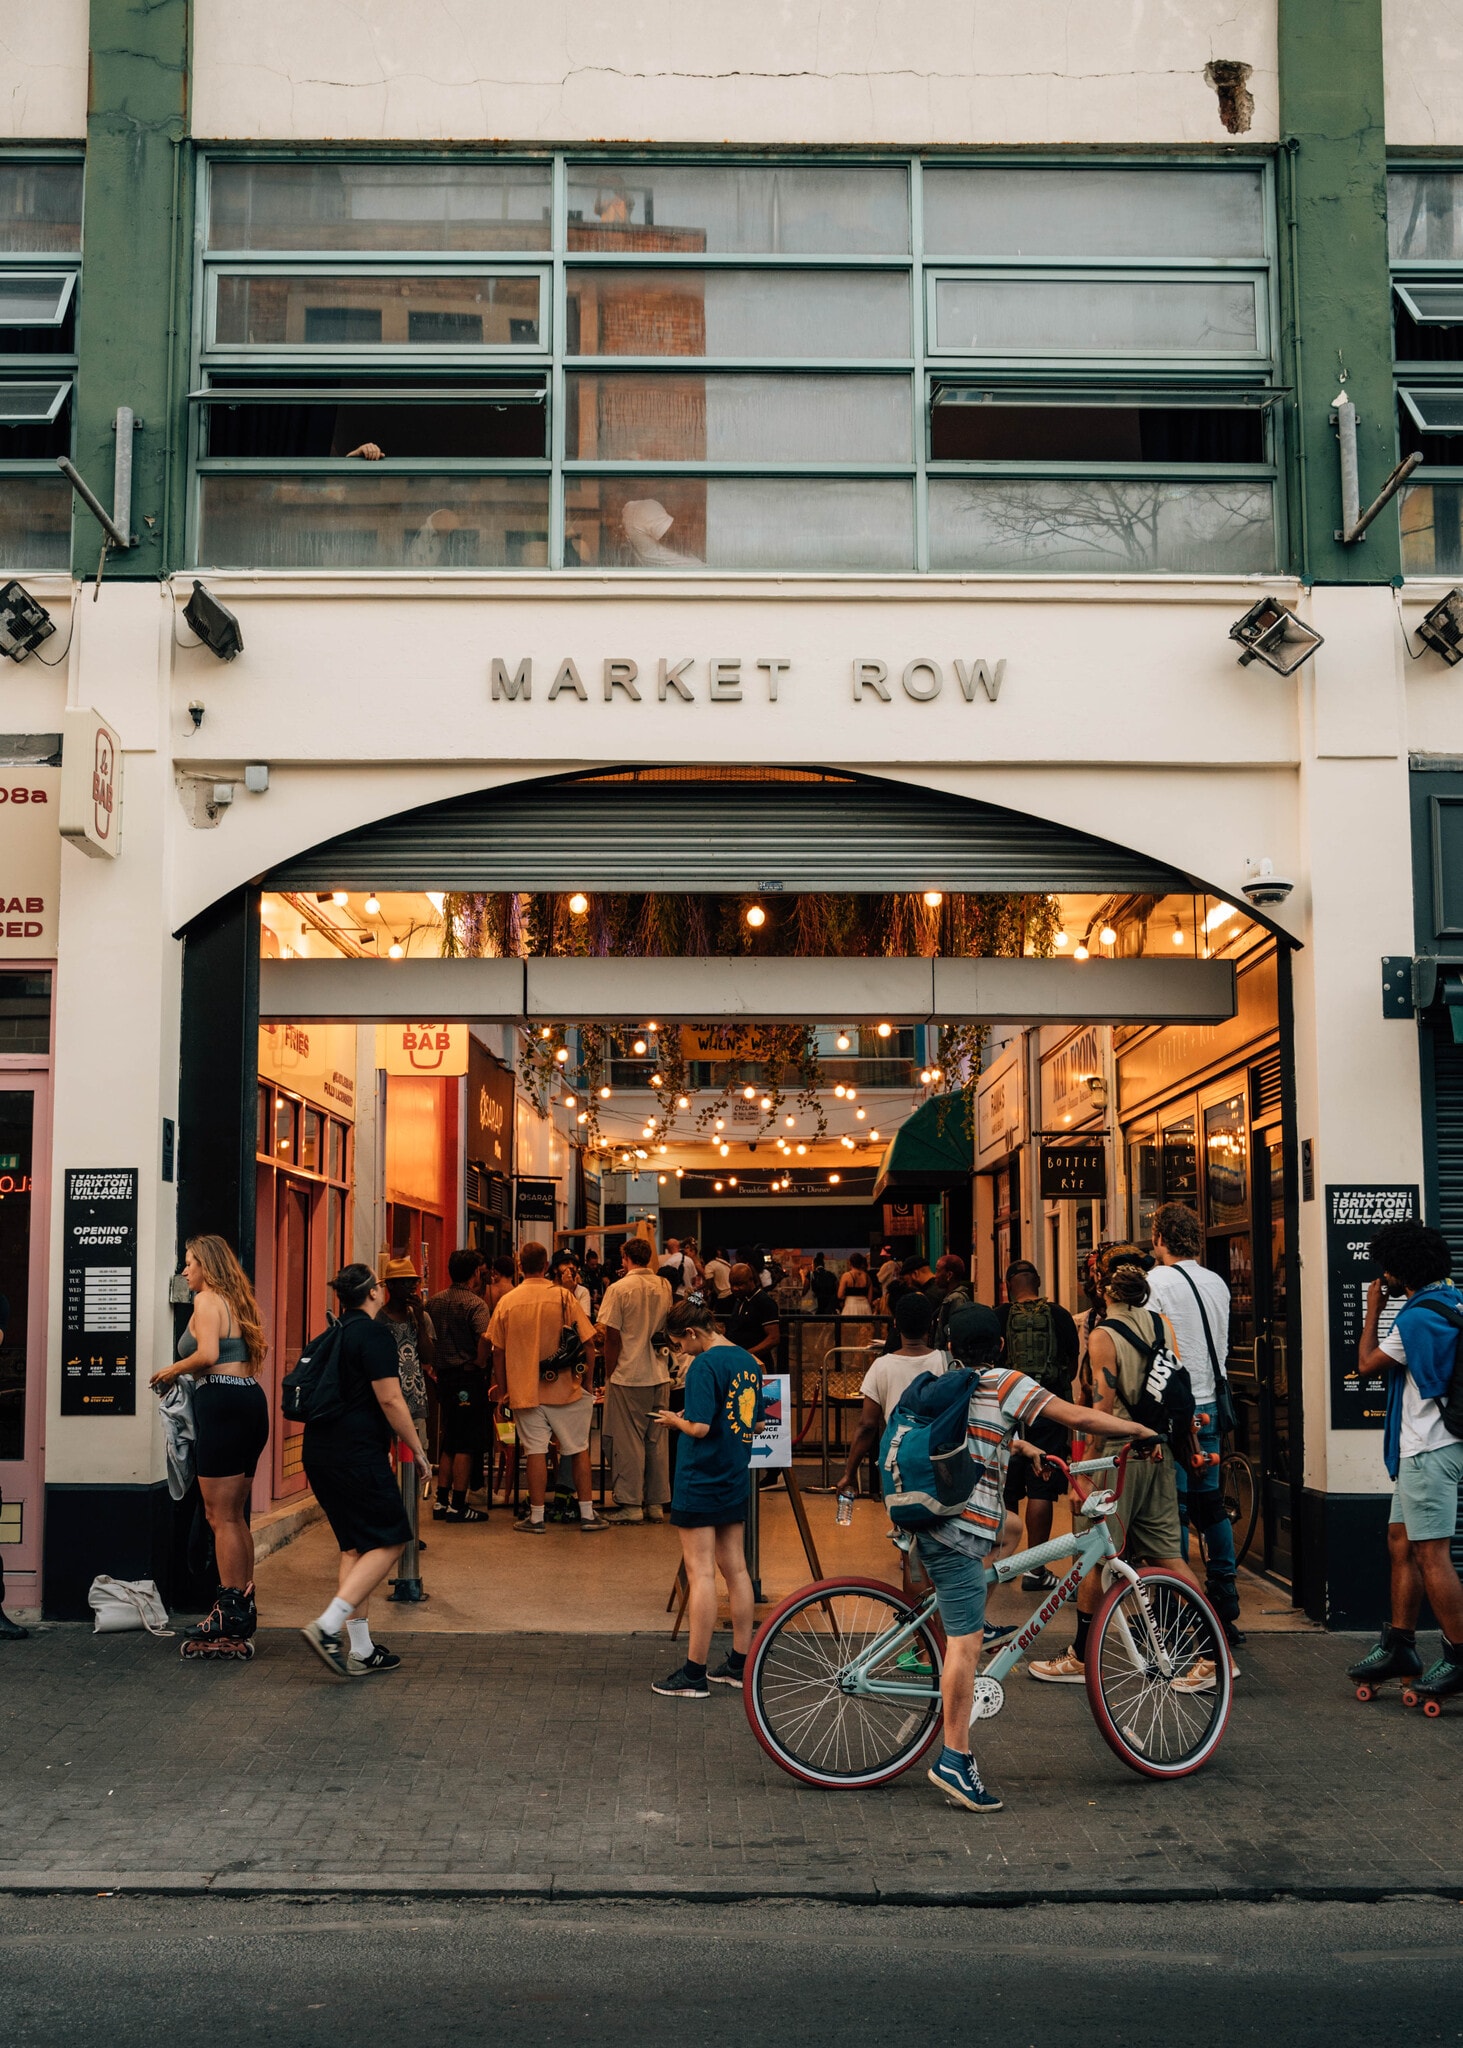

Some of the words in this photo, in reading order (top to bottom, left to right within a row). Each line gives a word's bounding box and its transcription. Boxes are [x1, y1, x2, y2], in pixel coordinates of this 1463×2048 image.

[491, 657, 791, 701] MARKET
[852, 657, 1008, 702] ROW
[92, 770, 113, 814] BAB
[0, 898, 45, 914] AB
[0, 922, 44, 938] ED
[285, 1024, 310, 1059] FRIES
[402, 1032, 451, 1050] BAB
[1047, 1156, 1098, 1169] BOTTLE
[75, 1179, 128, 1188] BRIXTON
[1061, 1178, 1085, 1189] RYE
[74, 1187, 127, 1196] VILLAGE
[1339, 1198, 1407, 1208] BRIXTON
[1339, 1208, 1404, 1219] VILLAGE
[73, 1226, 129, 1236] OPENING
[79, 1236, 122, 1245] HOURS
[209, 1374, 247, 1386] GYMSHARK
[371, 1654, 384, 1666] N
